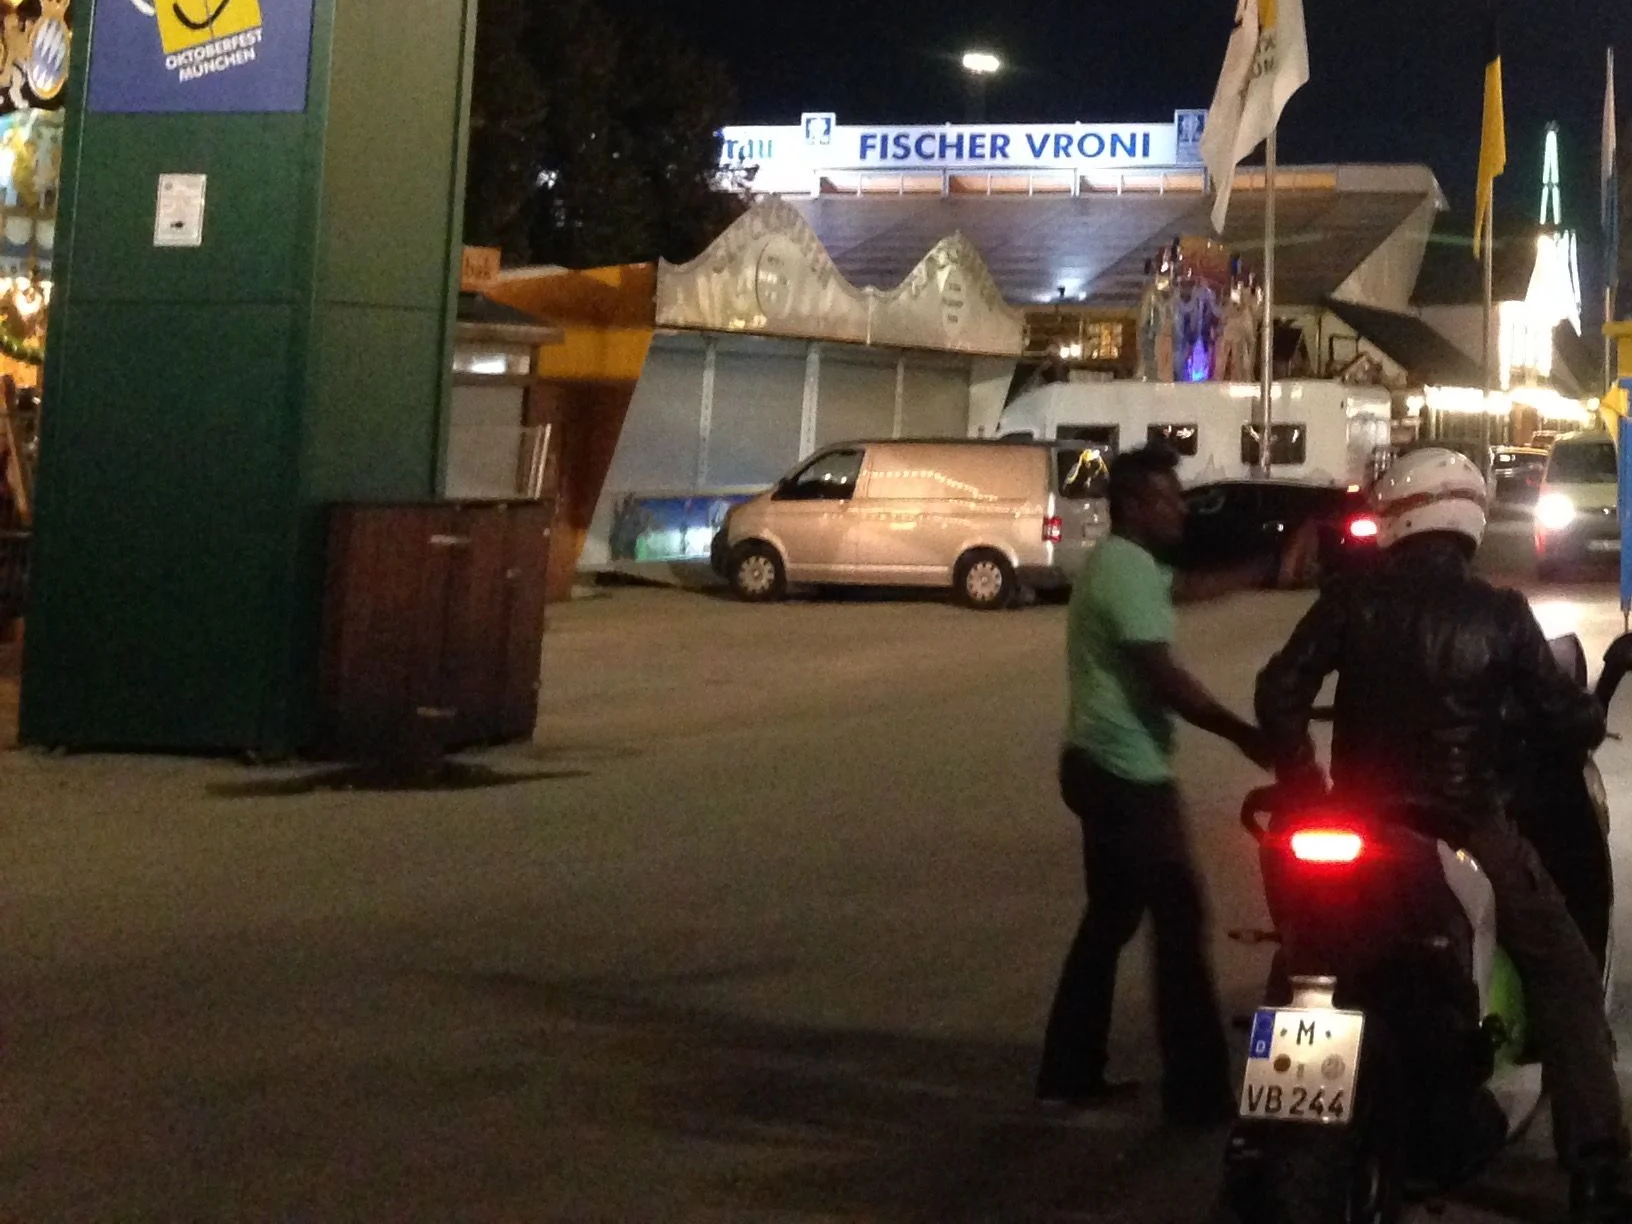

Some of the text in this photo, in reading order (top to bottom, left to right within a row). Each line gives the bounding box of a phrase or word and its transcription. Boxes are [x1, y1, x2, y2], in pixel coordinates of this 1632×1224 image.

[165, 27, 263, 71] OKTOBERFEST
[859, 131, 1150, 161] FISCHER VRONI
[1256, 1040, 1266, 1054] D
[1296, 1019, 1315, 1046] M
[1246, 1083, 1344, 1118] VB 244
